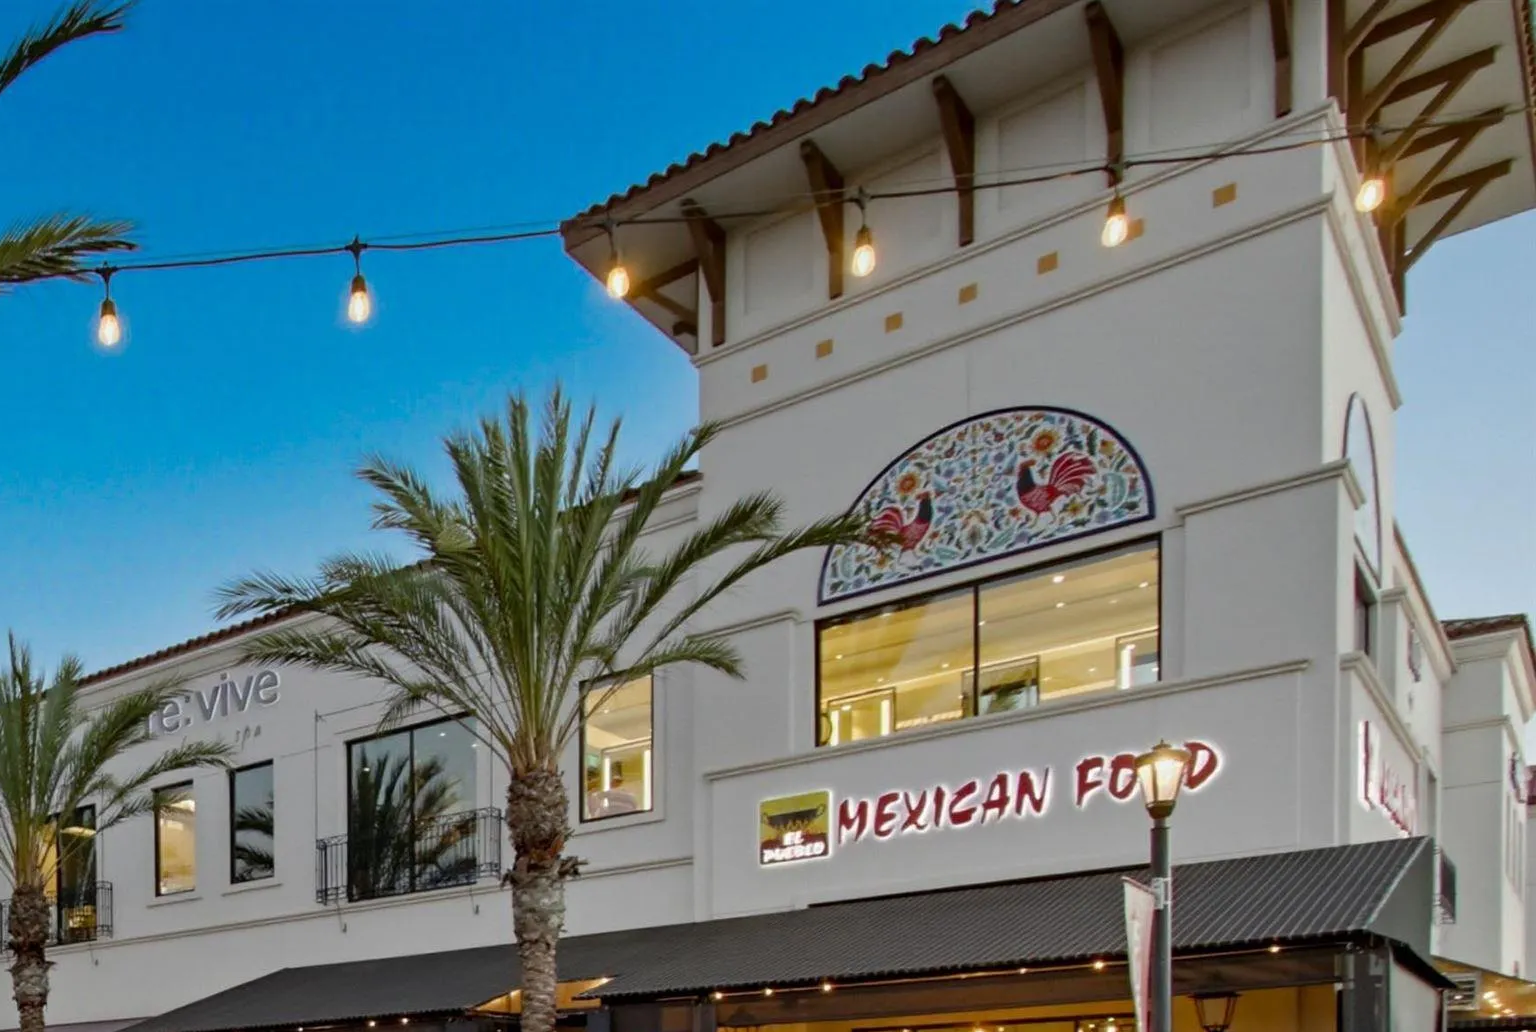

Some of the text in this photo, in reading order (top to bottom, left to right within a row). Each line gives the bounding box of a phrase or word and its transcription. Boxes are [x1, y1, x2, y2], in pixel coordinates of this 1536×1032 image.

[837, 741, 1220, 845] MEXICAN FOD
[783, 831, 804, 845] EL
[763, 841, 825, 862] PUEBLO
